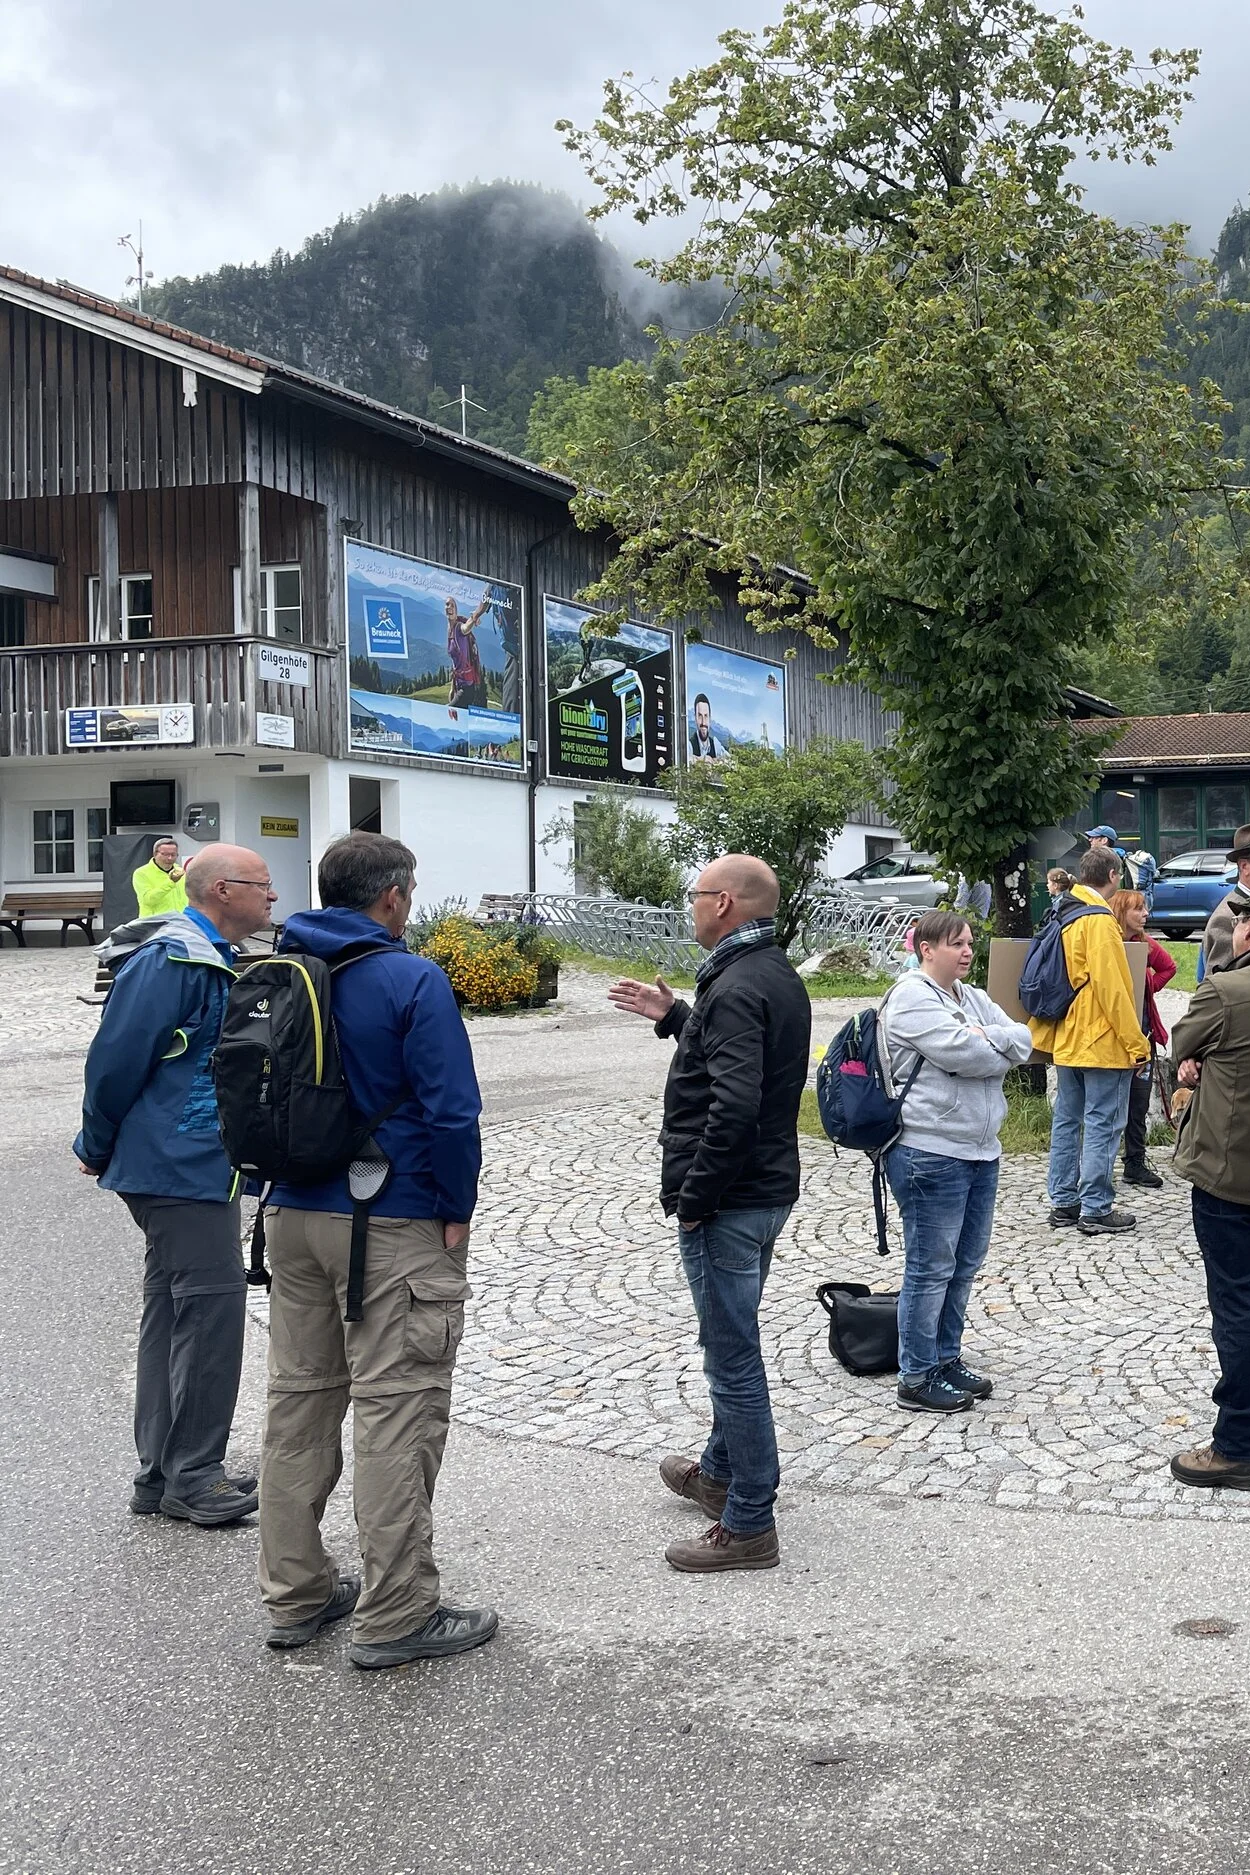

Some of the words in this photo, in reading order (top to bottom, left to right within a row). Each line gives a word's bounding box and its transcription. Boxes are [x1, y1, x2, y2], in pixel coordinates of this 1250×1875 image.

[371, 627, 402, 638] Brauneck
[261, 650, 307, 668] Gilgenhöfe
[279, 667, 290, 679] 28
[560, 741, 575, 752] HOHE
[576, 743, 608, 757] WASCHKRAFT
[561, 752, 571, 762] MIT
[571, 754, 609, 767] GERUCHSSTOPP
[262, 822, 275, 831] KEIN
[276, 823, 298, 832] ZUGANG
[248, 1010, 271, 1019] deuter
